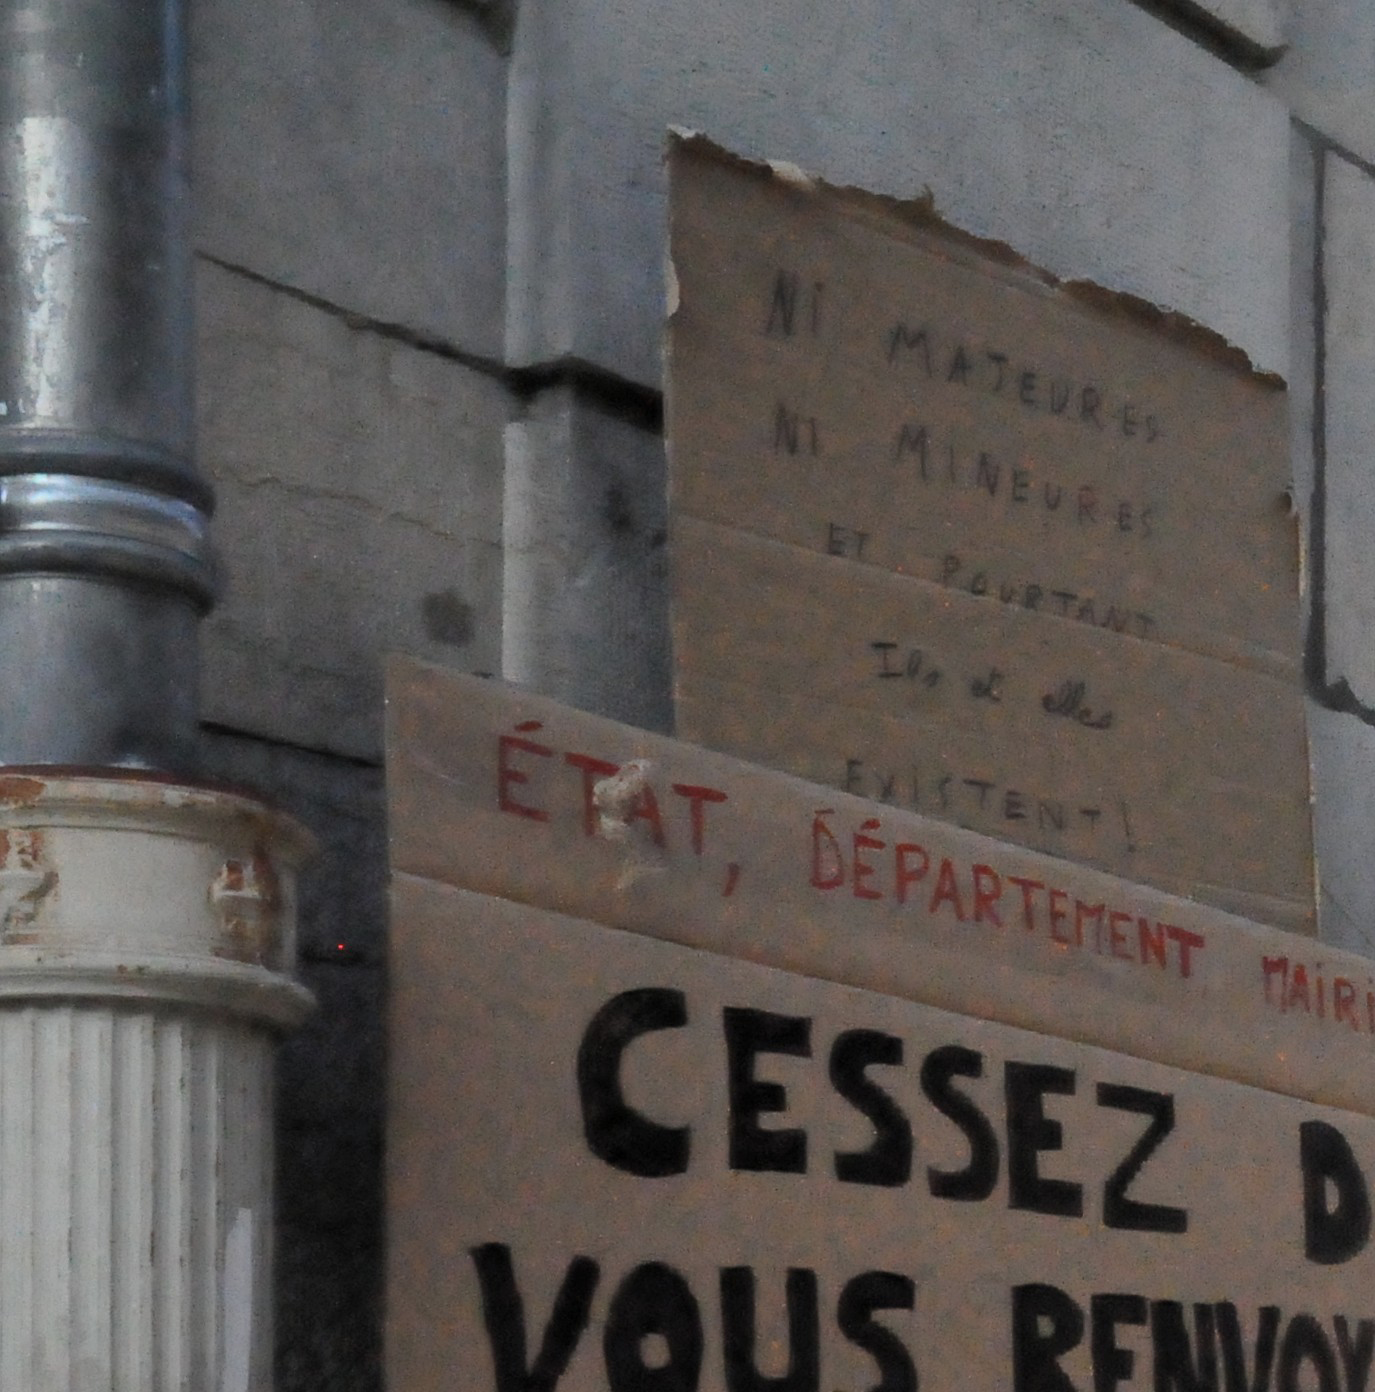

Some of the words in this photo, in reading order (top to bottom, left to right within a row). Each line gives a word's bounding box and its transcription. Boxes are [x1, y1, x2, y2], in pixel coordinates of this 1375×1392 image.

[827, 522, 871, 557] ET
[810, 808, 1206, 979] DÉPARTEMENT
[575, 986, 1188, 1235] CESSEZ
